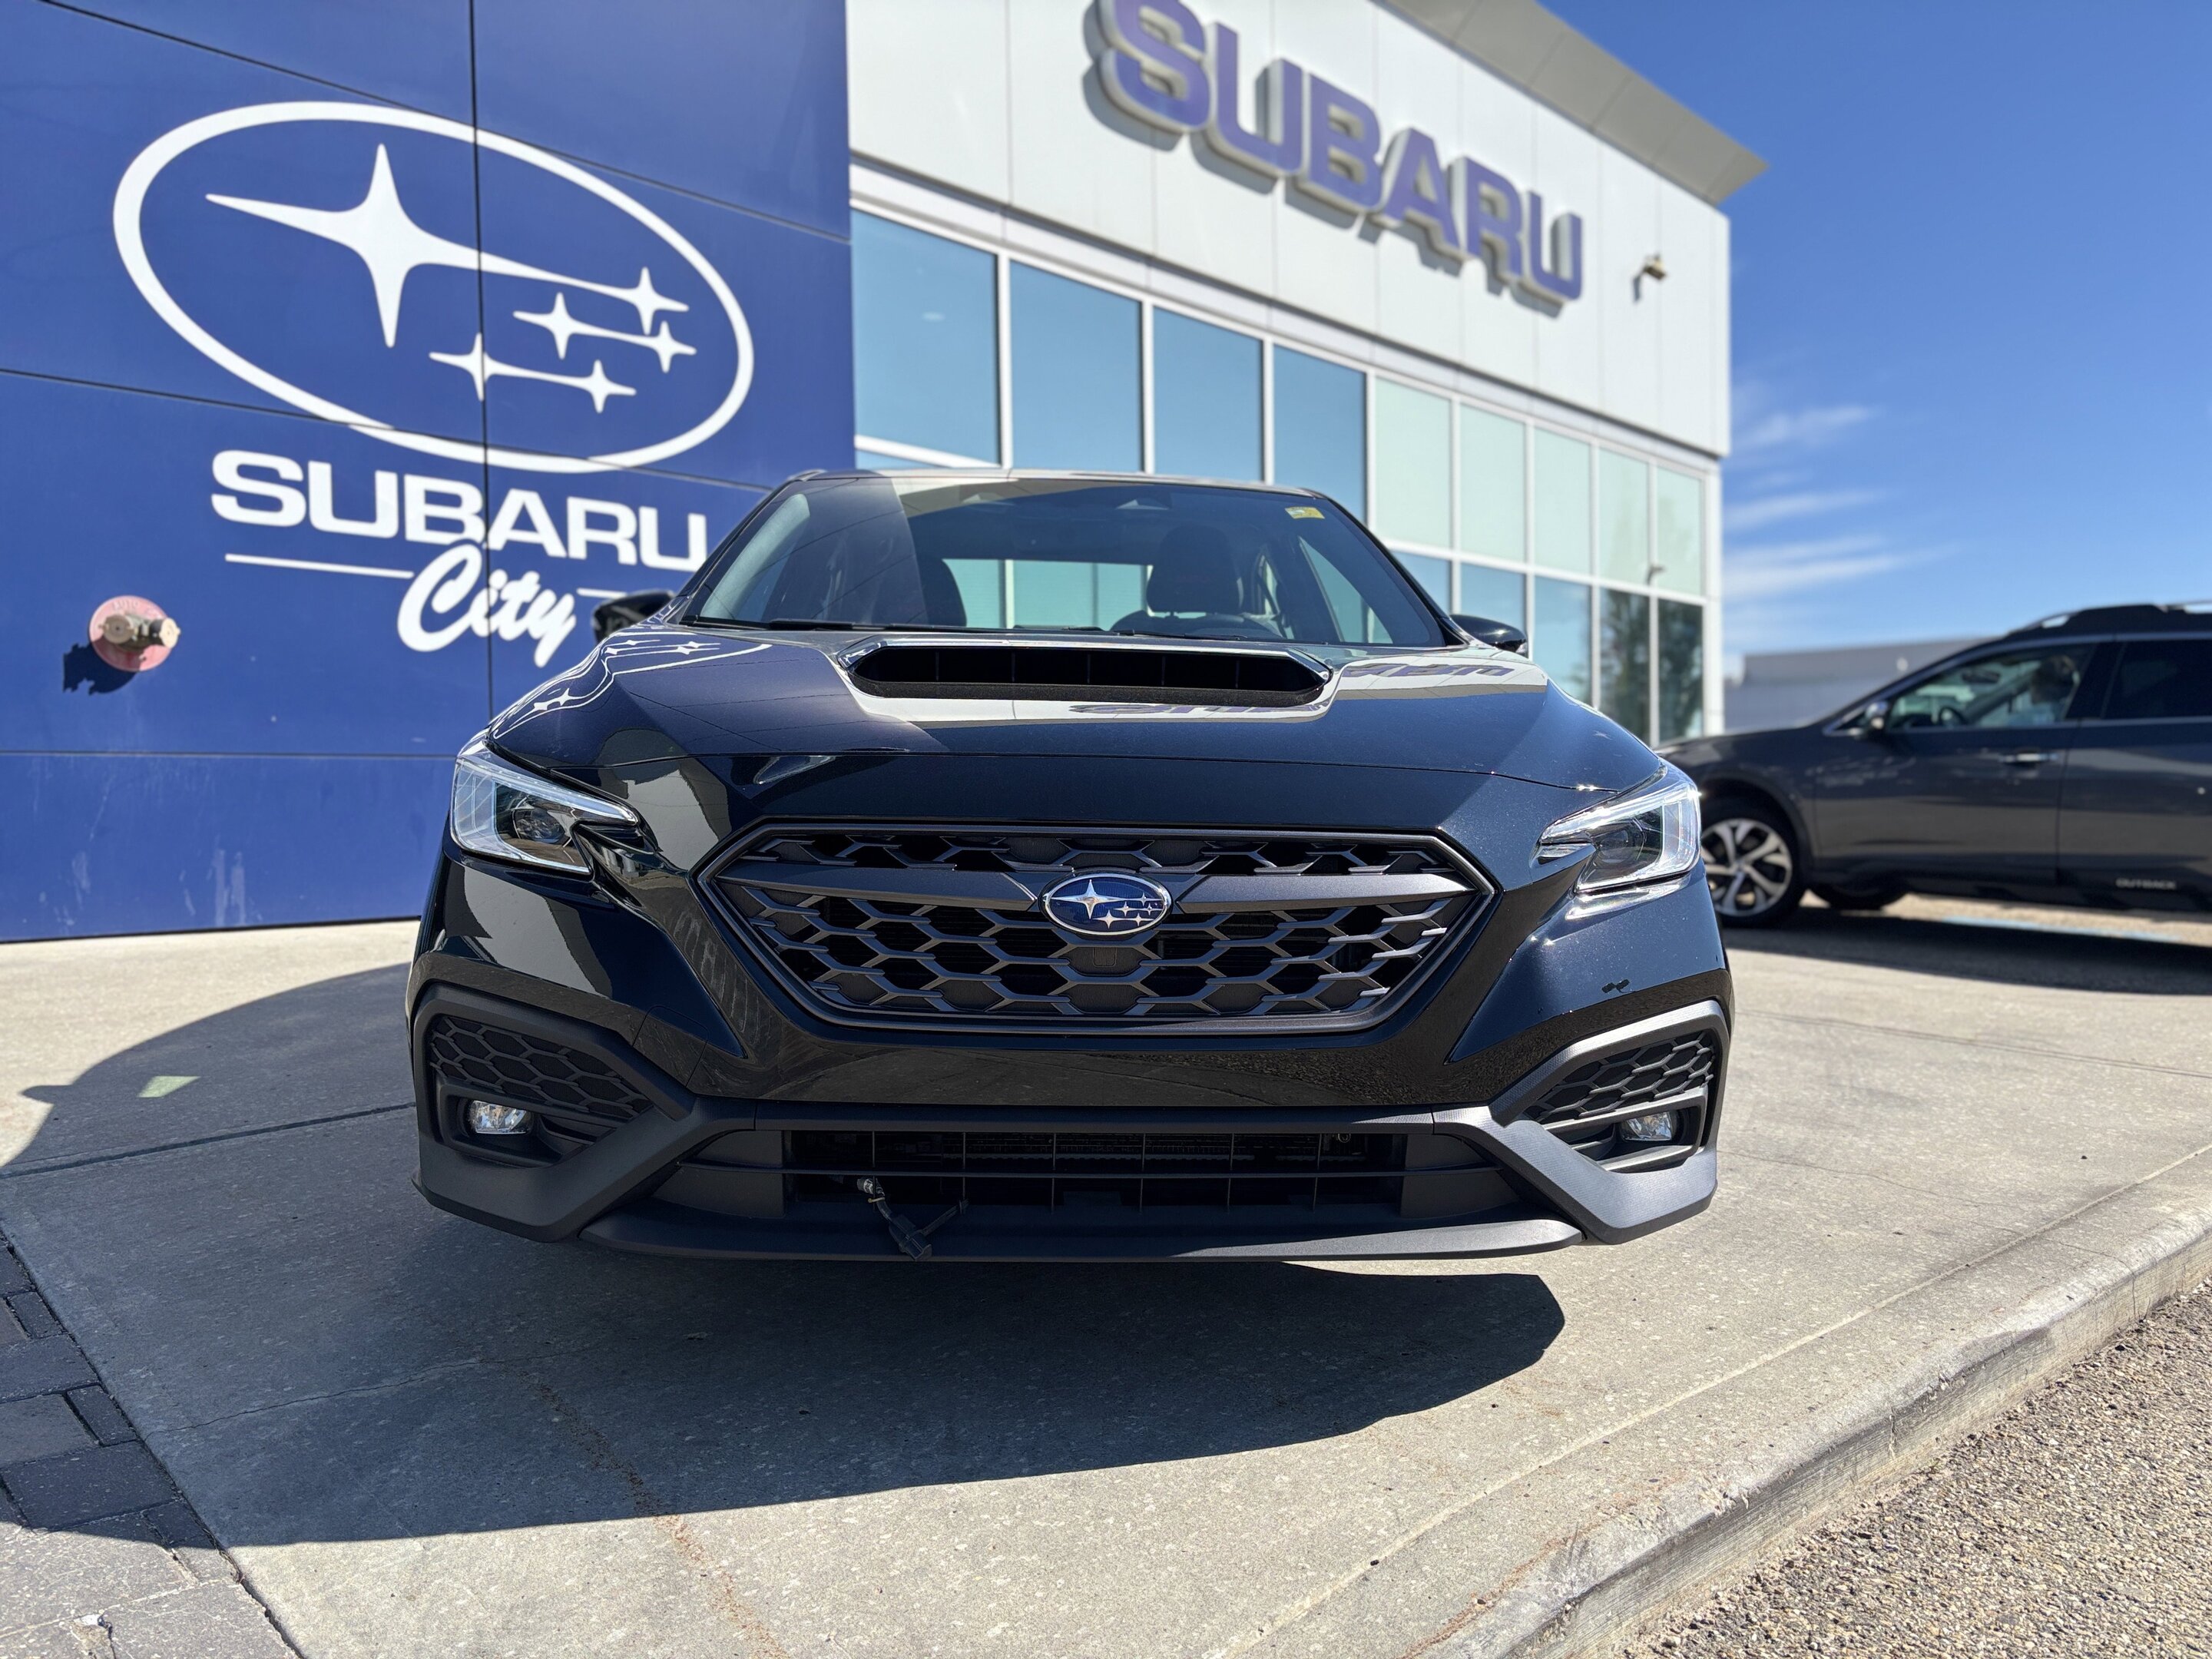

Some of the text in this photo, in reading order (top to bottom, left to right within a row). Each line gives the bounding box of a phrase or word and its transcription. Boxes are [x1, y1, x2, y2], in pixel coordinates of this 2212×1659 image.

[1097, 0, 1584, 304] SUBARU
[211, 450, 707, 573] SUBARU
[397, 544, 577, 667] City
